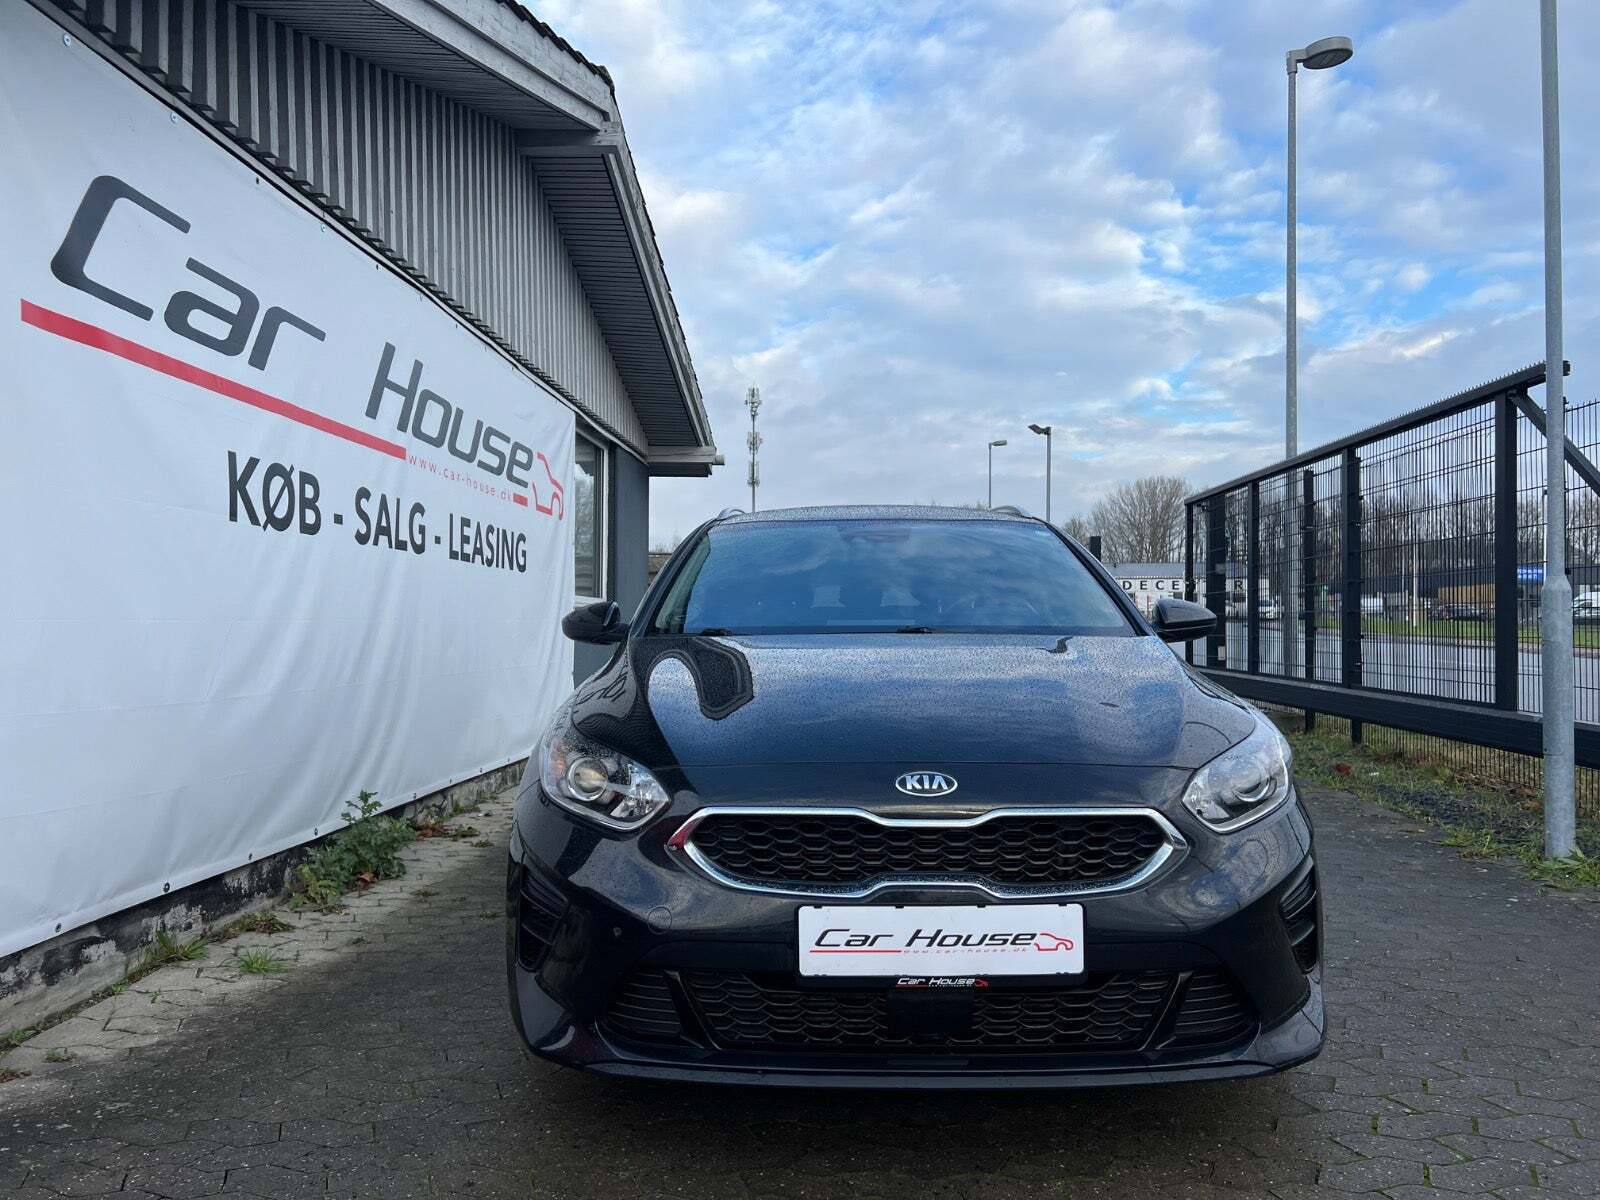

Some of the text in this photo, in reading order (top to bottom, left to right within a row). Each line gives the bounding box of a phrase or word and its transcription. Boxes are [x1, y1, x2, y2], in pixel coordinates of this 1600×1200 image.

[51, 175, 534, 488] Car House
[227, 451, 322, 536] KØB
[355, 486, 426, 555] SALG
[449, 513, 528, 573] LEASING
[905, 774, 948, 790] KIA
[815, 929, 1037, 947] Car House
[897, 977, 976, 985] Car House
